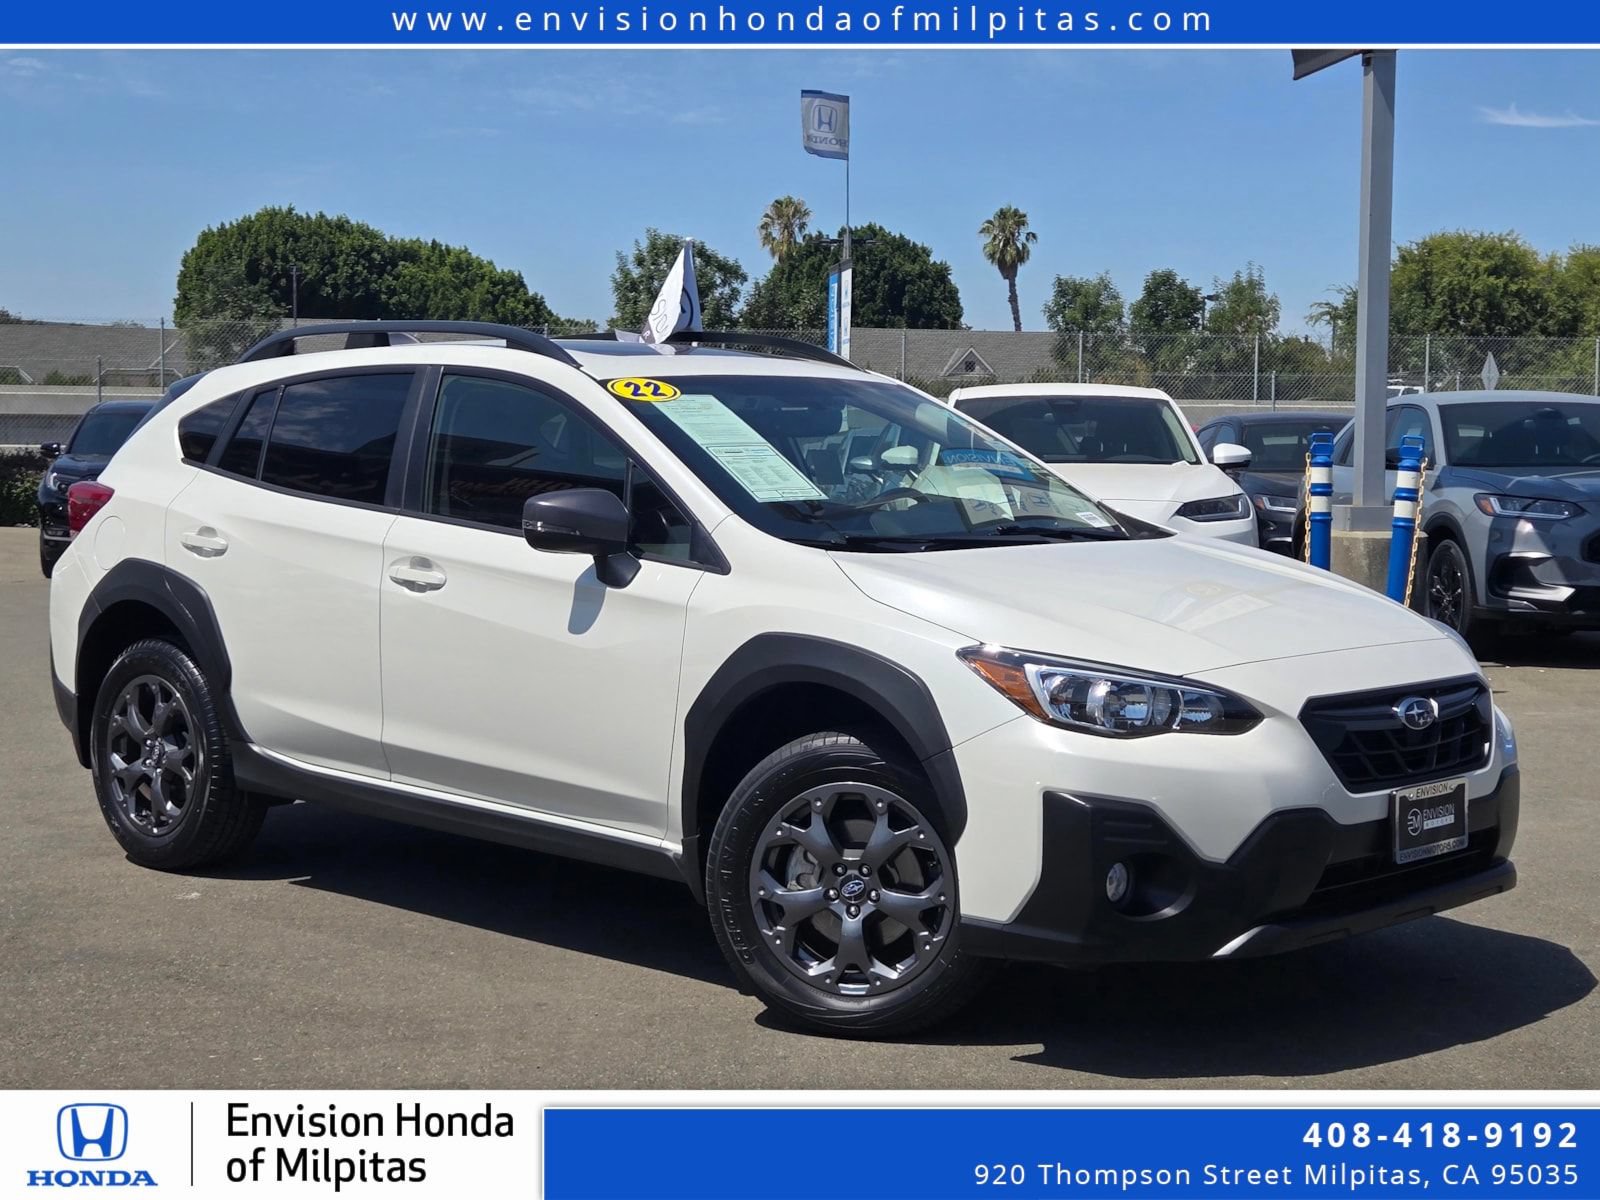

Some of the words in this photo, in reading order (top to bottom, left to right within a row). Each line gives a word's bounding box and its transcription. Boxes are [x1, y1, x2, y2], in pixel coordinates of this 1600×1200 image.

[624, 381, 668, 397] 22
[1416, 782, 1449, 798] ENVISION
[1423, 803, 1455, 821] ENVISION
